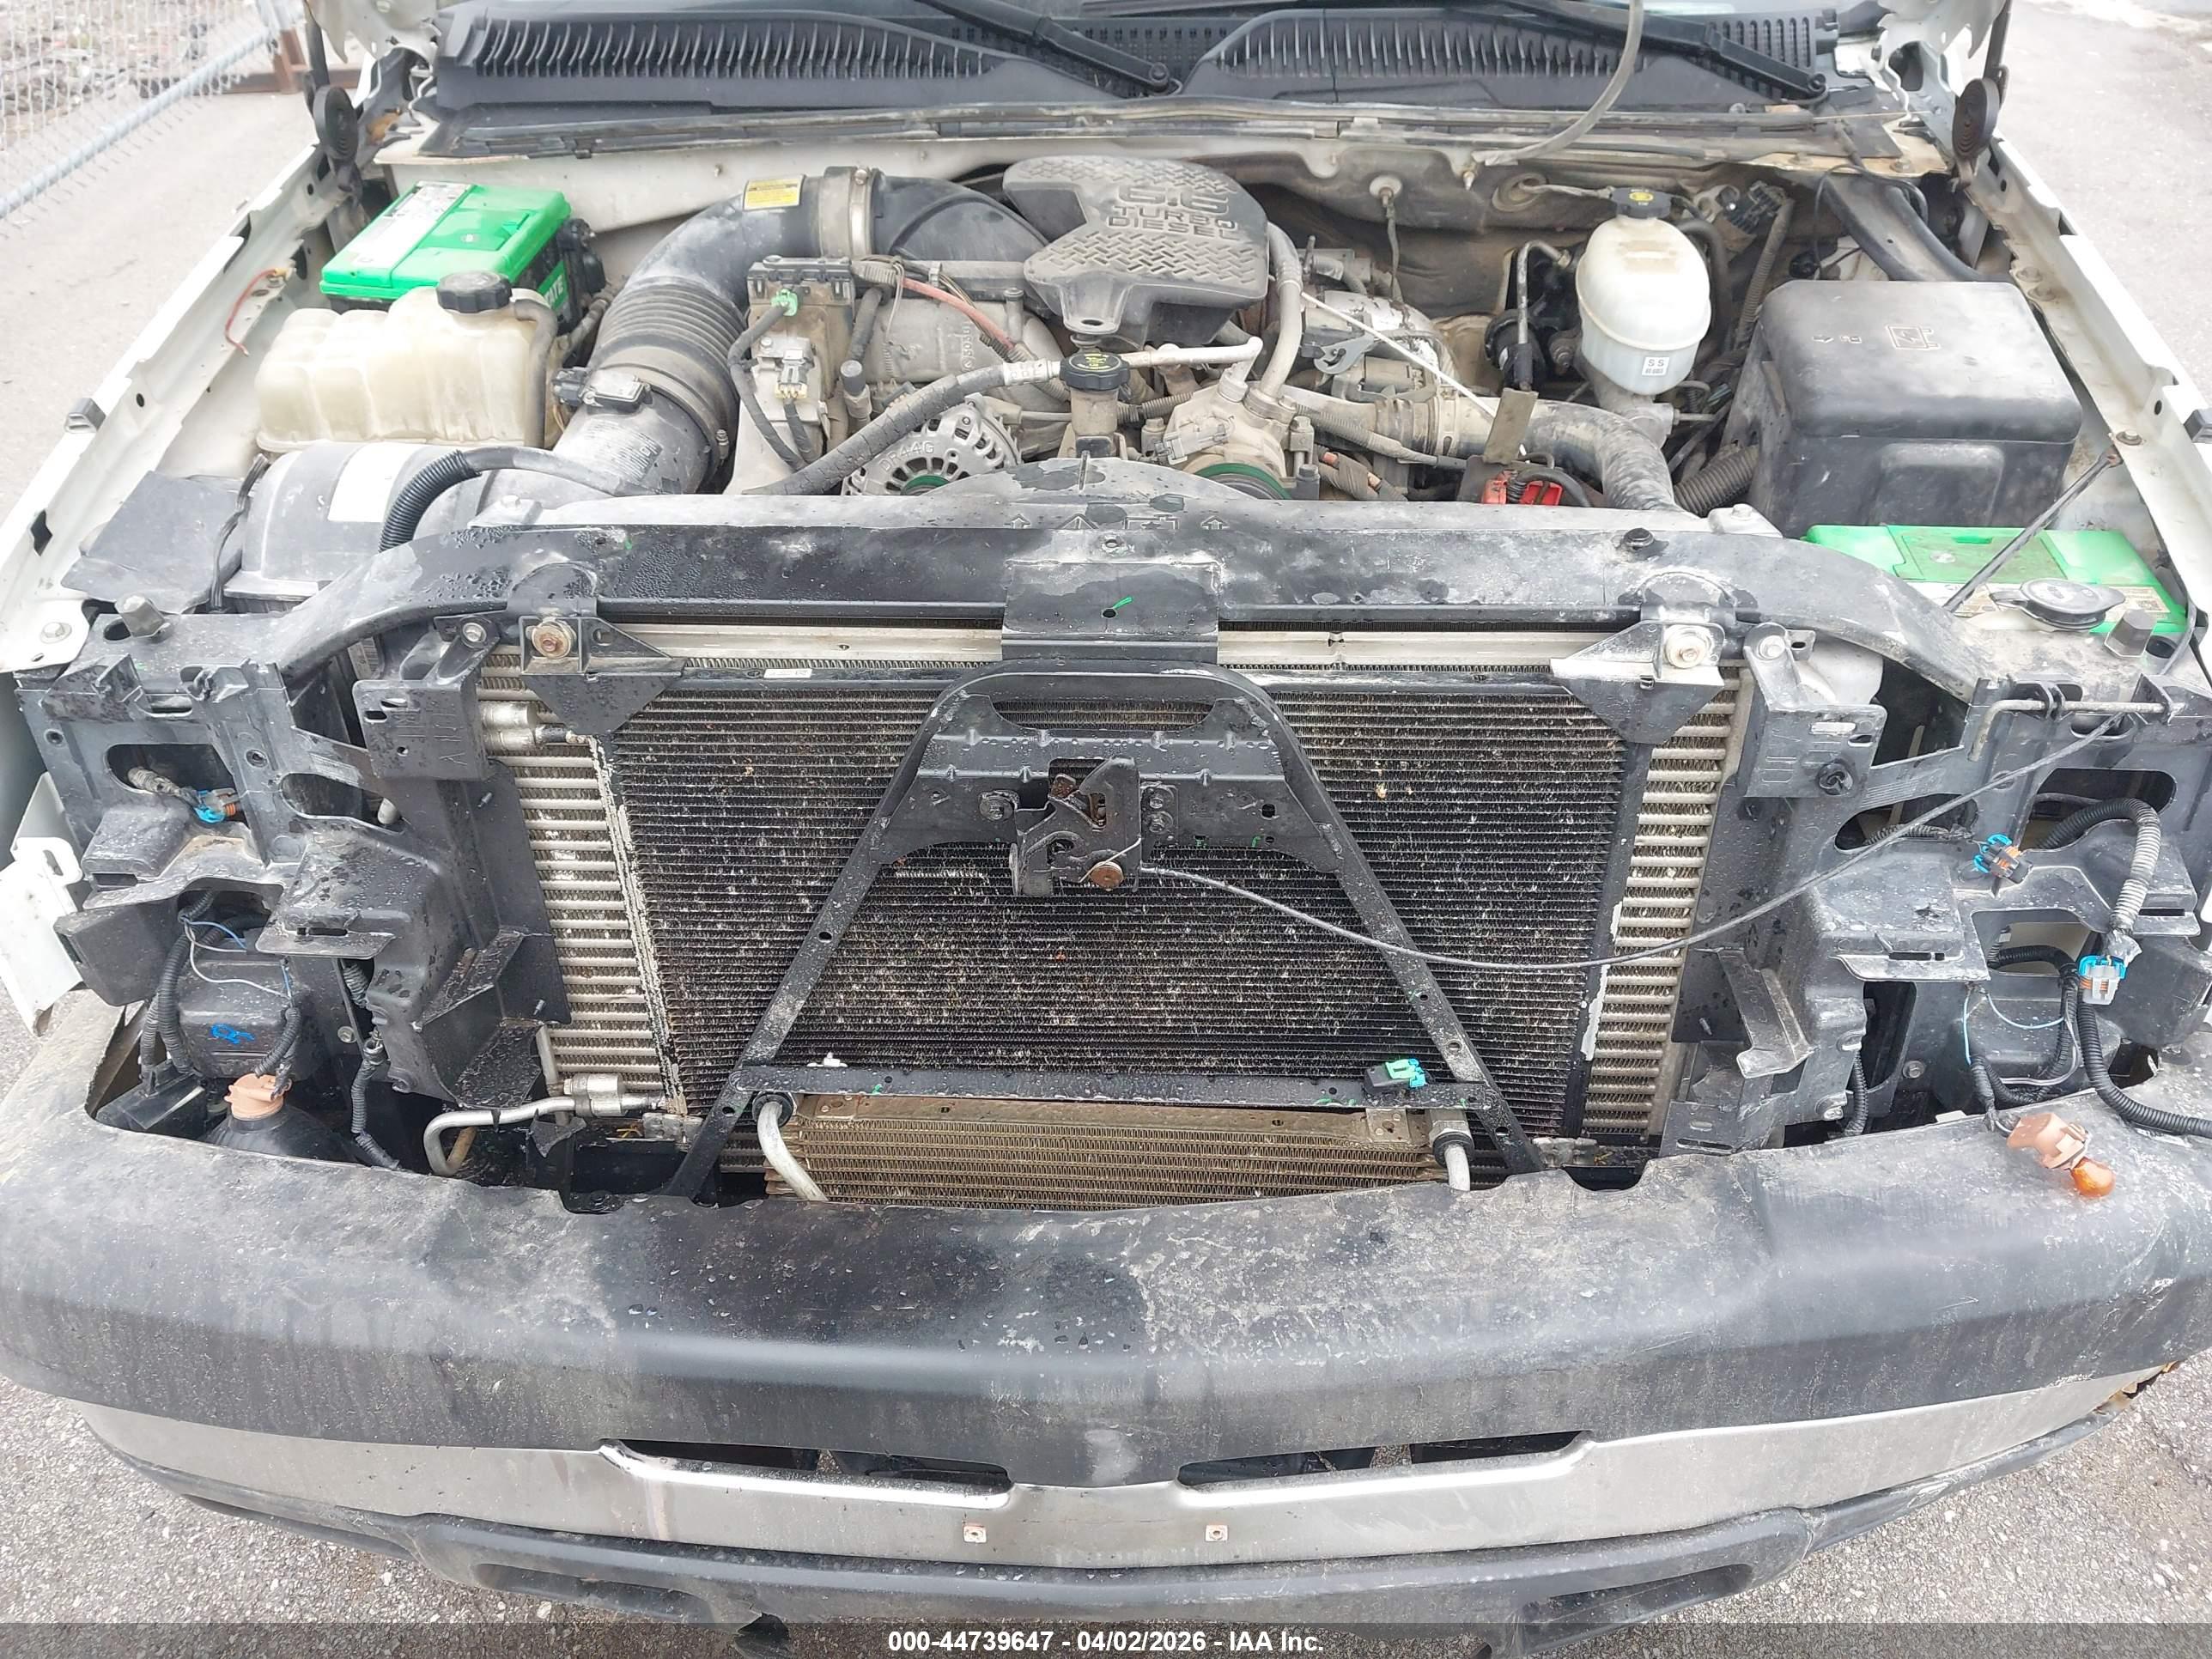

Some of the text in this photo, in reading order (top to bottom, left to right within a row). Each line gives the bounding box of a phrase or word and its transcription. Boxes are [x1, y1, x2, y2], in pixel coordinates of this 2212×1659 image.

[1117, 185, 1229, 215] 6.6
[1108, 216, 1241, 241] DIESEL
[1113, 205, 1238, 230] TURBO
[878, 441, 934, 471] DR44G
